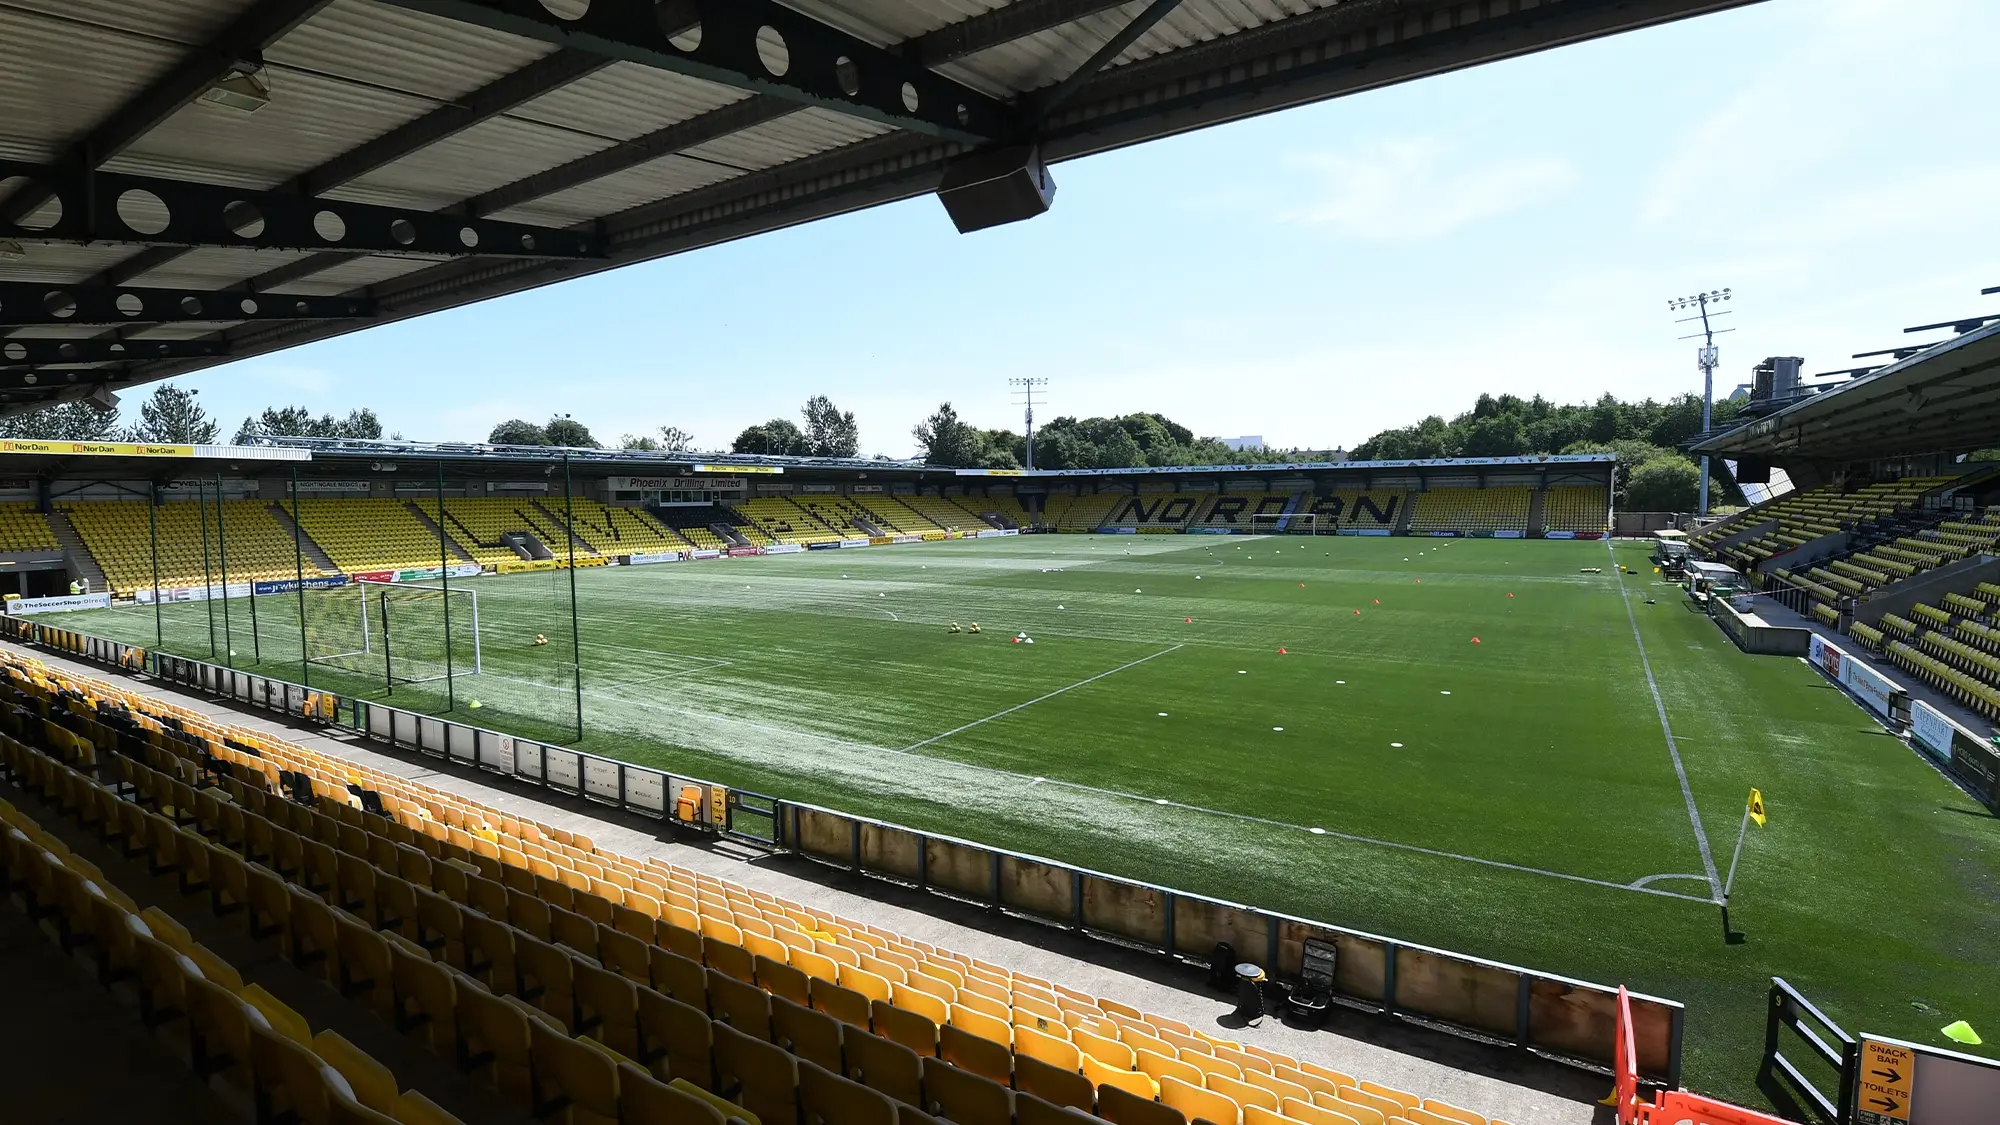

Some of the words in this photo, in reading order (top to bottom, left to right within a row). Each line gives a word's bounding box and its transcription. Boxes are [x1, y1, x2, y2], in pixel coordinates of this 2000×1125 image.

[15, 443, 49, 451] NorDan
[83, 445, 115, 453] NorDan
[630, 477, 667, 488] Phoenix
[674, 478, 705, 489] Drilling
[711, 479, 741, 488] Limited
[1115, 496, 1399, 523] NORDAN
[729, 795, 736, 804] 10
[1775, 994, 1782, 1007] 9
[1869, 1044, 1908, 1059] SNACK
[1877, 1054, 1899, 1066] BAR
[1863, 1082, 1909, 1099] TOILETS
[1860, 1110, 1876, 1119] FIRE
[1860, 1115, 1876, 1123] EXIT
